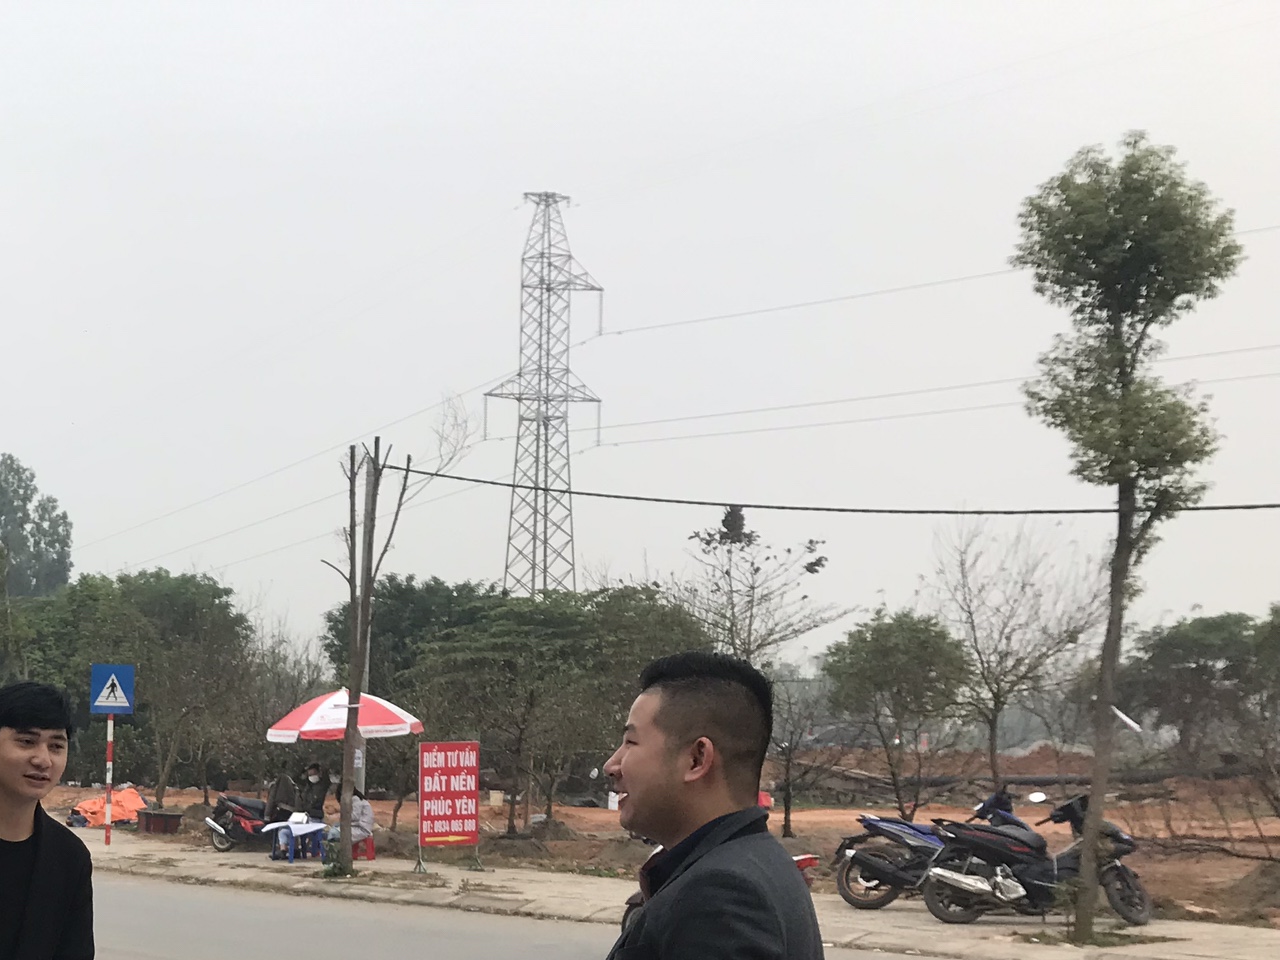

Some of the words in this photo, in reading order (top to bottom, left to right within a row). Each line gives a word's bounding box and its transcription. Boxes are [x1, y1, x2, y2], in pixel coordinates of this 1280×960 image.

[423, 745, 445, 768] ĐIỂM
[446, 749, 458, 768] TƯ
[459, 745, 476, 767] VẤN
[424, 770, 447, 792] ĐẤT
[450, 769, 475, 791] NỀN
[423, 796, 452, 816] PHÚC
[455, 795, 476, 815] YÊN
